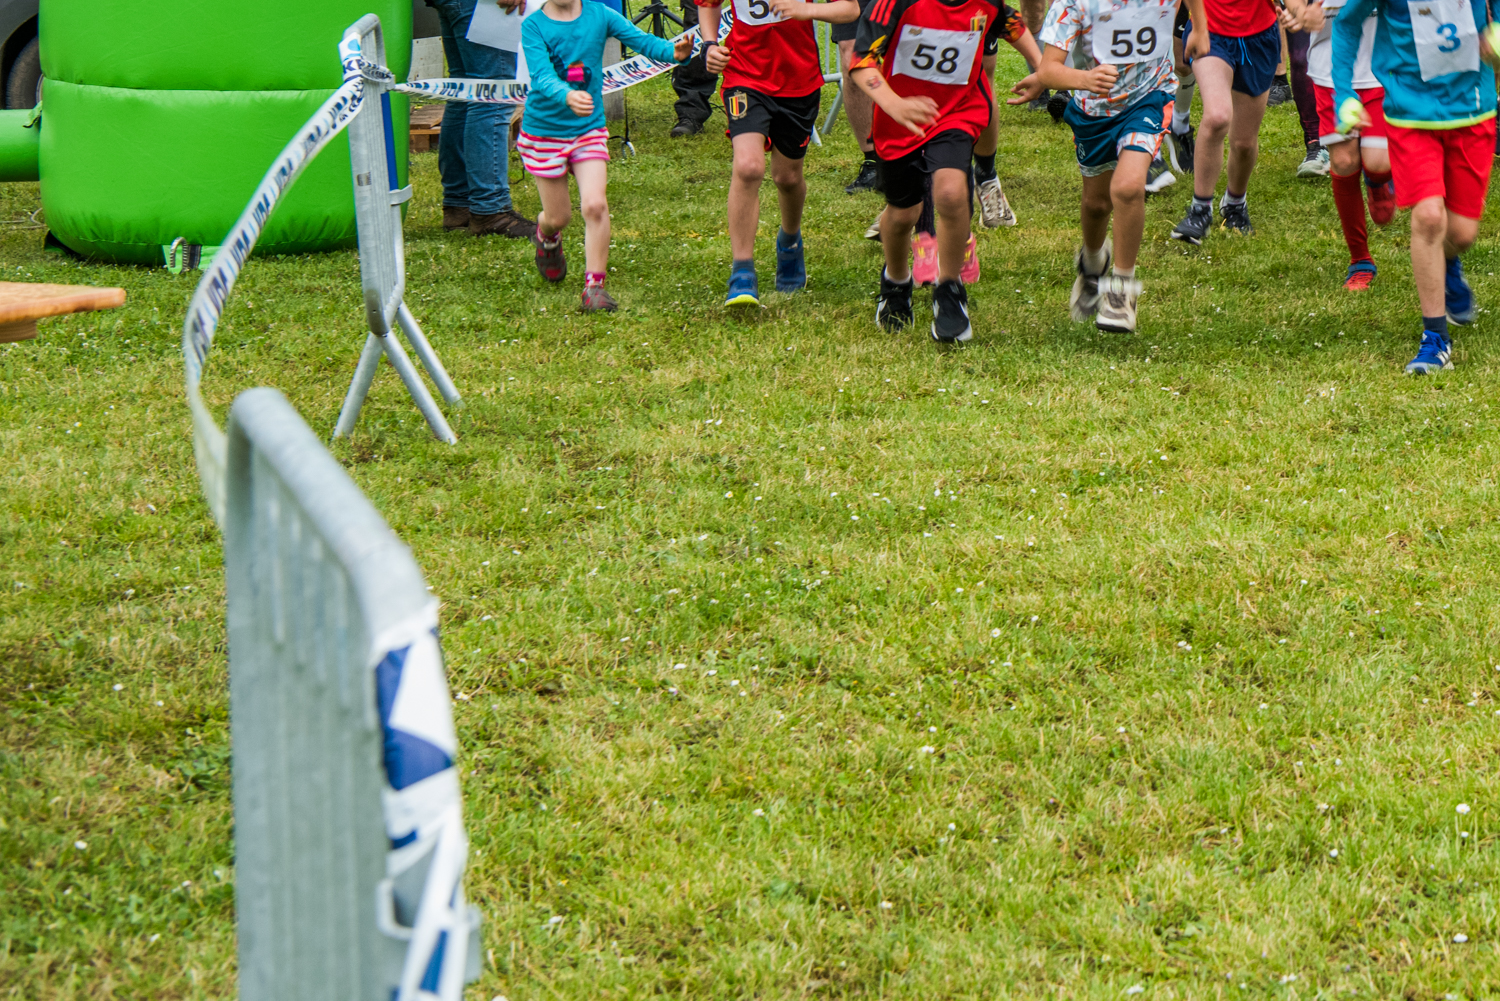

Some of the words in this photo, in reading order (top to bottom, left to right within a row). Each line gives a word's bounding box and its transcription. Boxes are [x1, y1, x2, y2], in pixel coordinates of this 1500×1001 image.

[1110, 26, 1157, 57] 59
[1437, 23, 1461, 53] 3
[911, 43, 959, 74] 58
